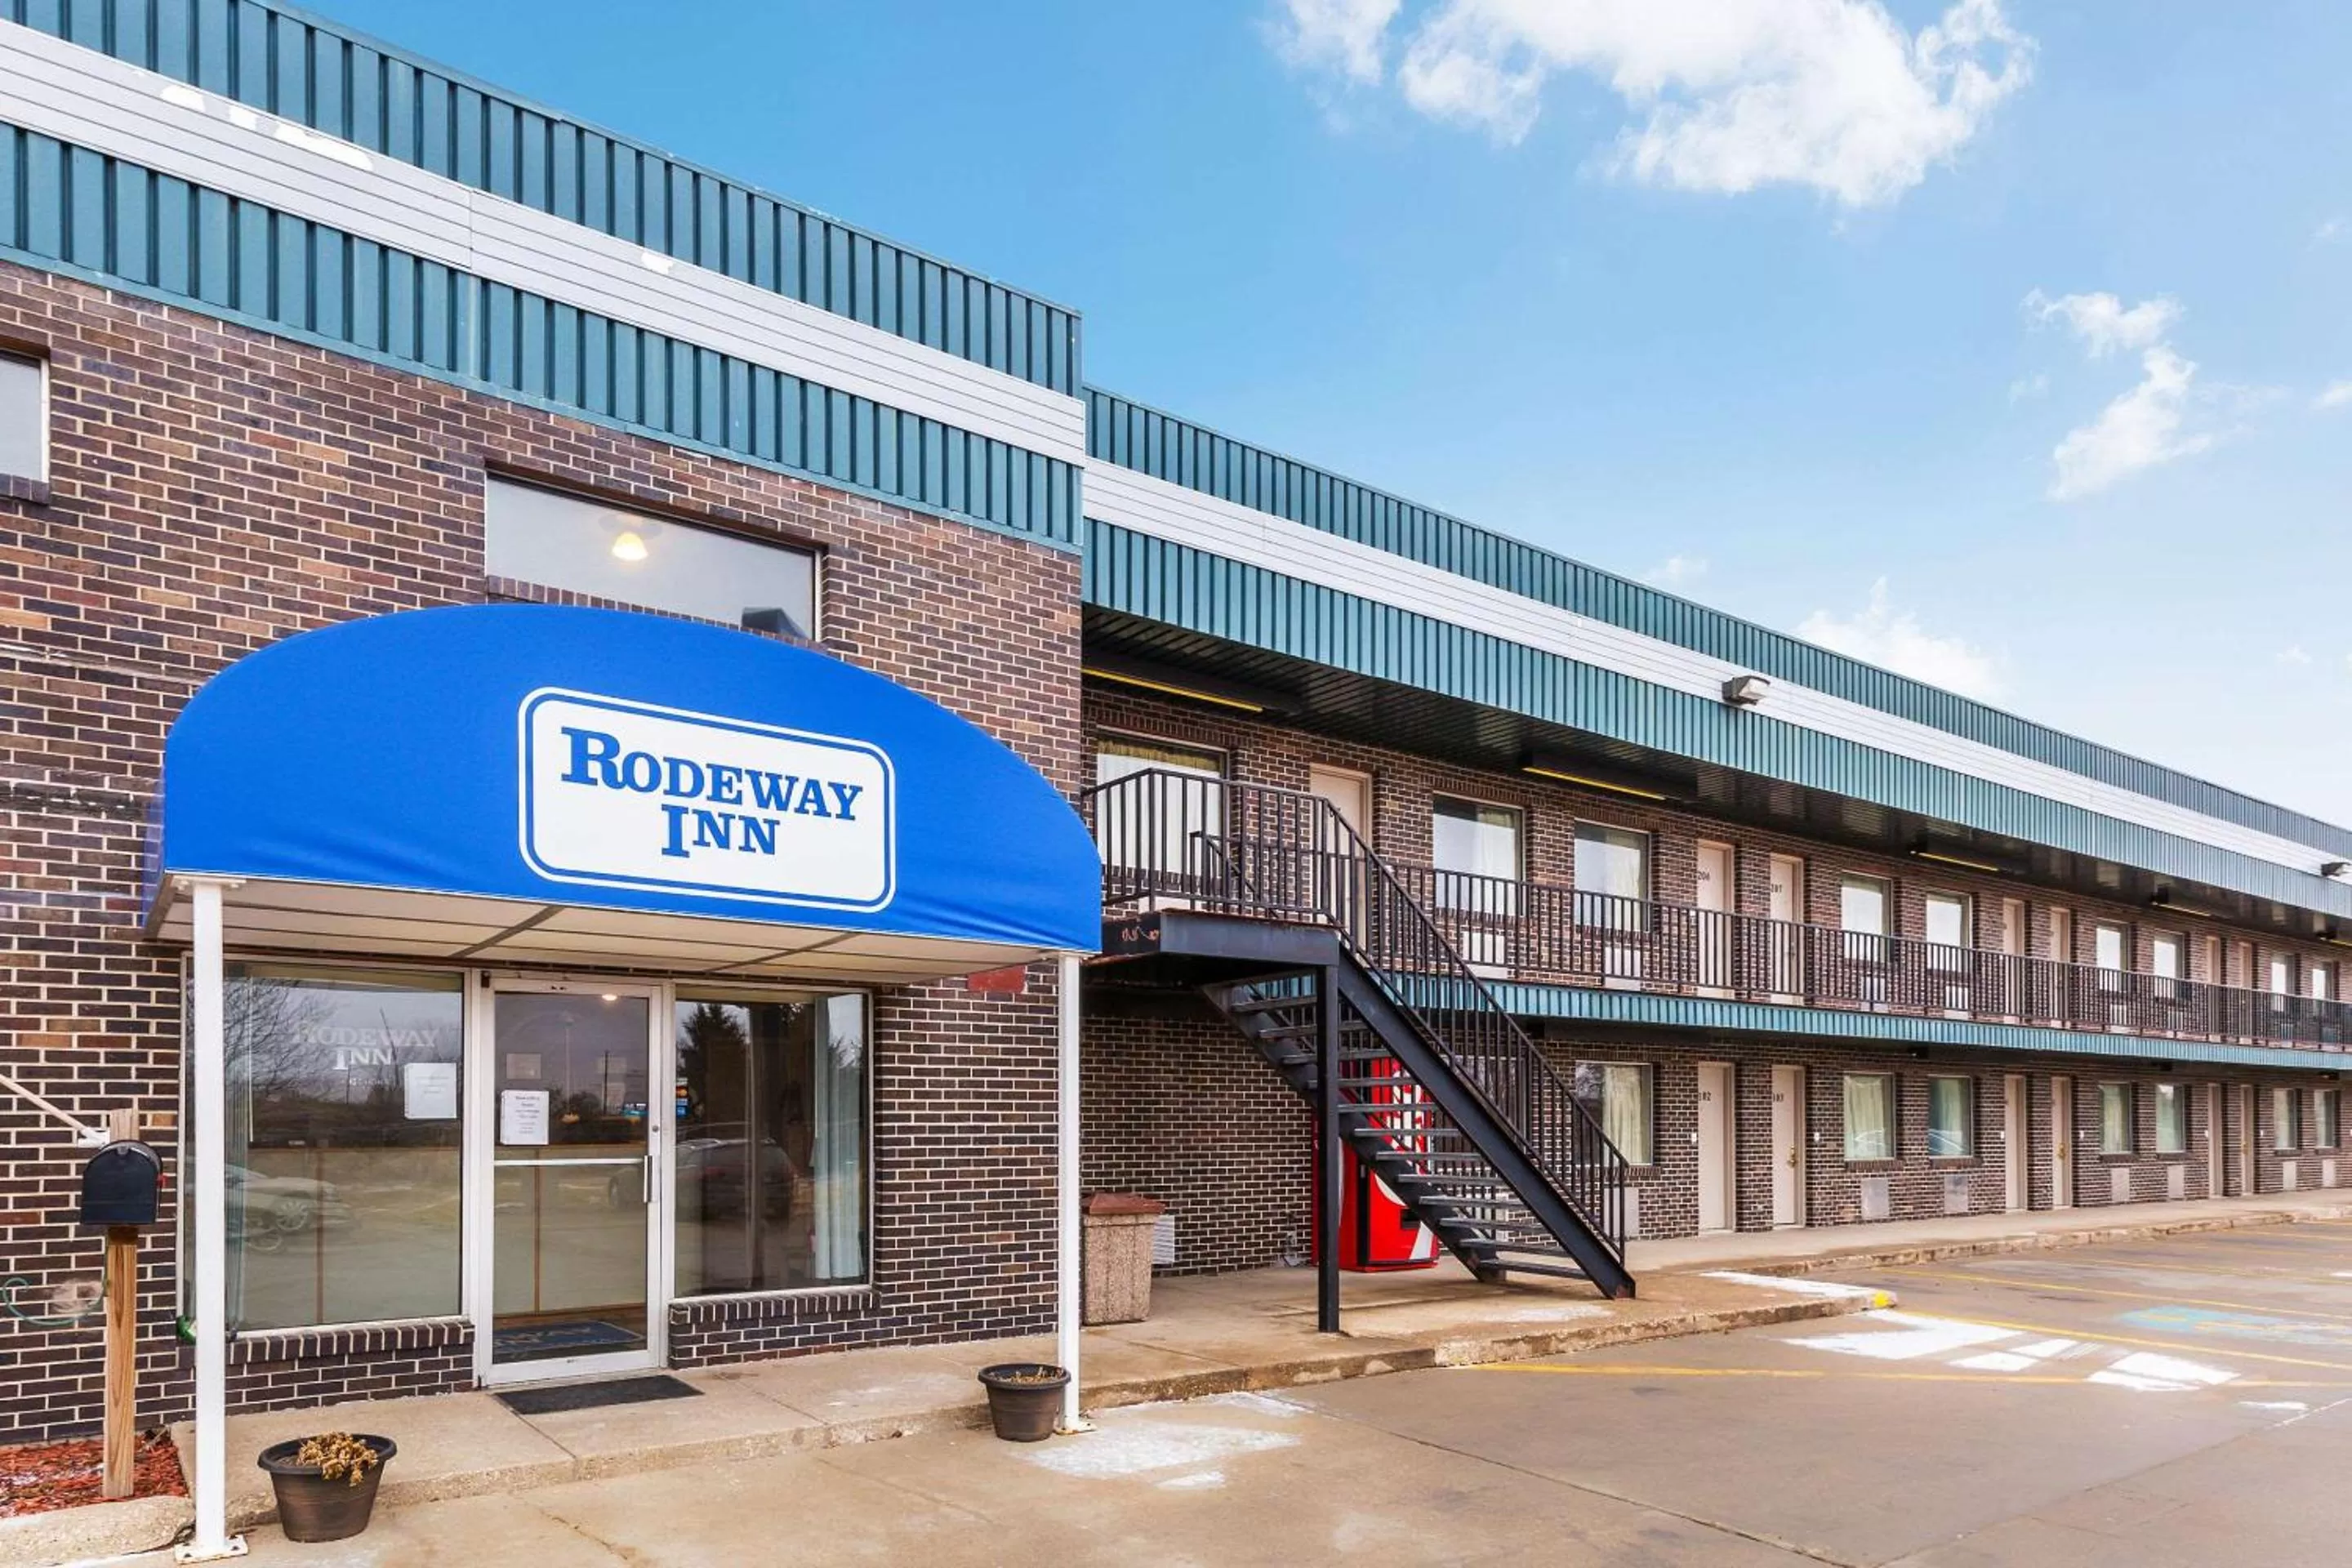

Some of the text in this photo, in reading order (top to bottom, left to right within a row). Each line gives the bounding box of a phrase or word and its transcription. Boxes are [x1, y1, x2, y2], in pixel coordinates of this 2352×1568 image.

[560, 726, 863, 821] RODEWAY
[661, 803, 781, 858] INN
[290, 1022, 440, 1048] RODEWAY
[332, 1047, 394, 1071] INN
